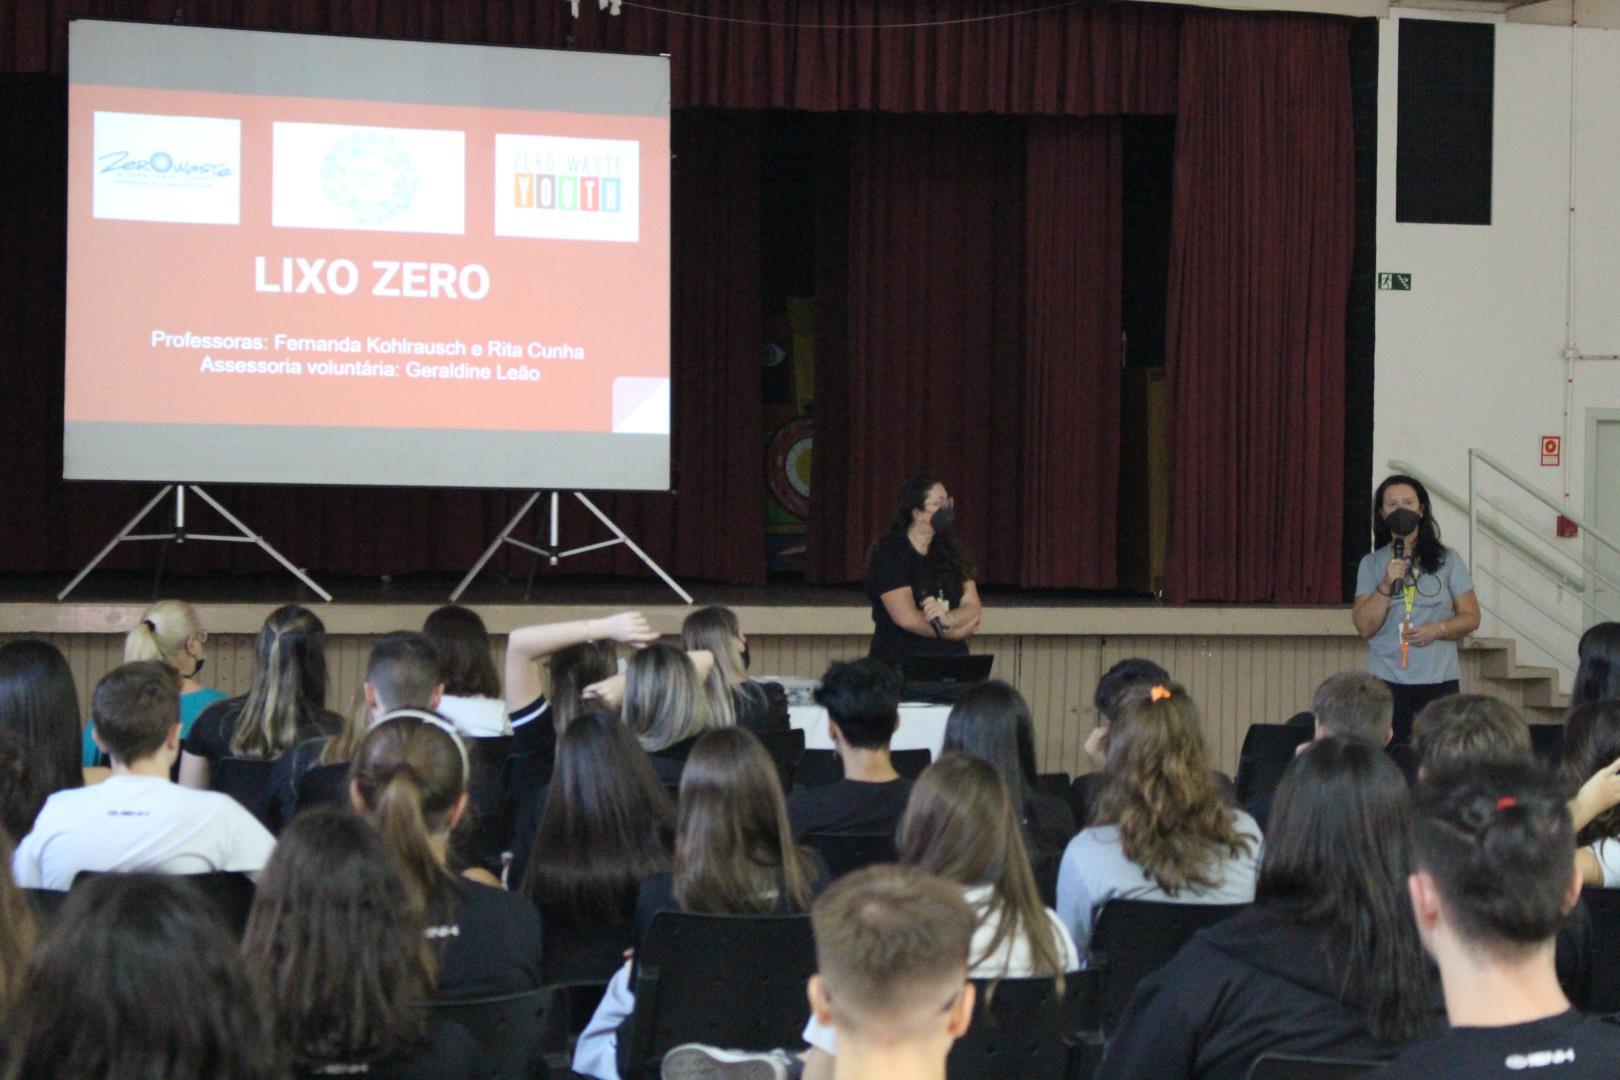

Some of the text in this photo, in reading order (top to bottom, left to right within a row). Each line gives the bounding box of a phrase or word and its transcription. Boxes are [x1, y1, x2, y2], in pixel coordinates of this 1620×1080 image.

[513, 151, 623, 176] ZERO WASTE
[516, 174, 620, 211] YOUTH
[254, 256, 491, 302] LIXO ZERO
[151, 330, 585, 360] Professoras: Fernanda Kohlrausch e Rita Cunha
[200, 355, 541, 381] Assessoria voluntária: Geraldine Leão
